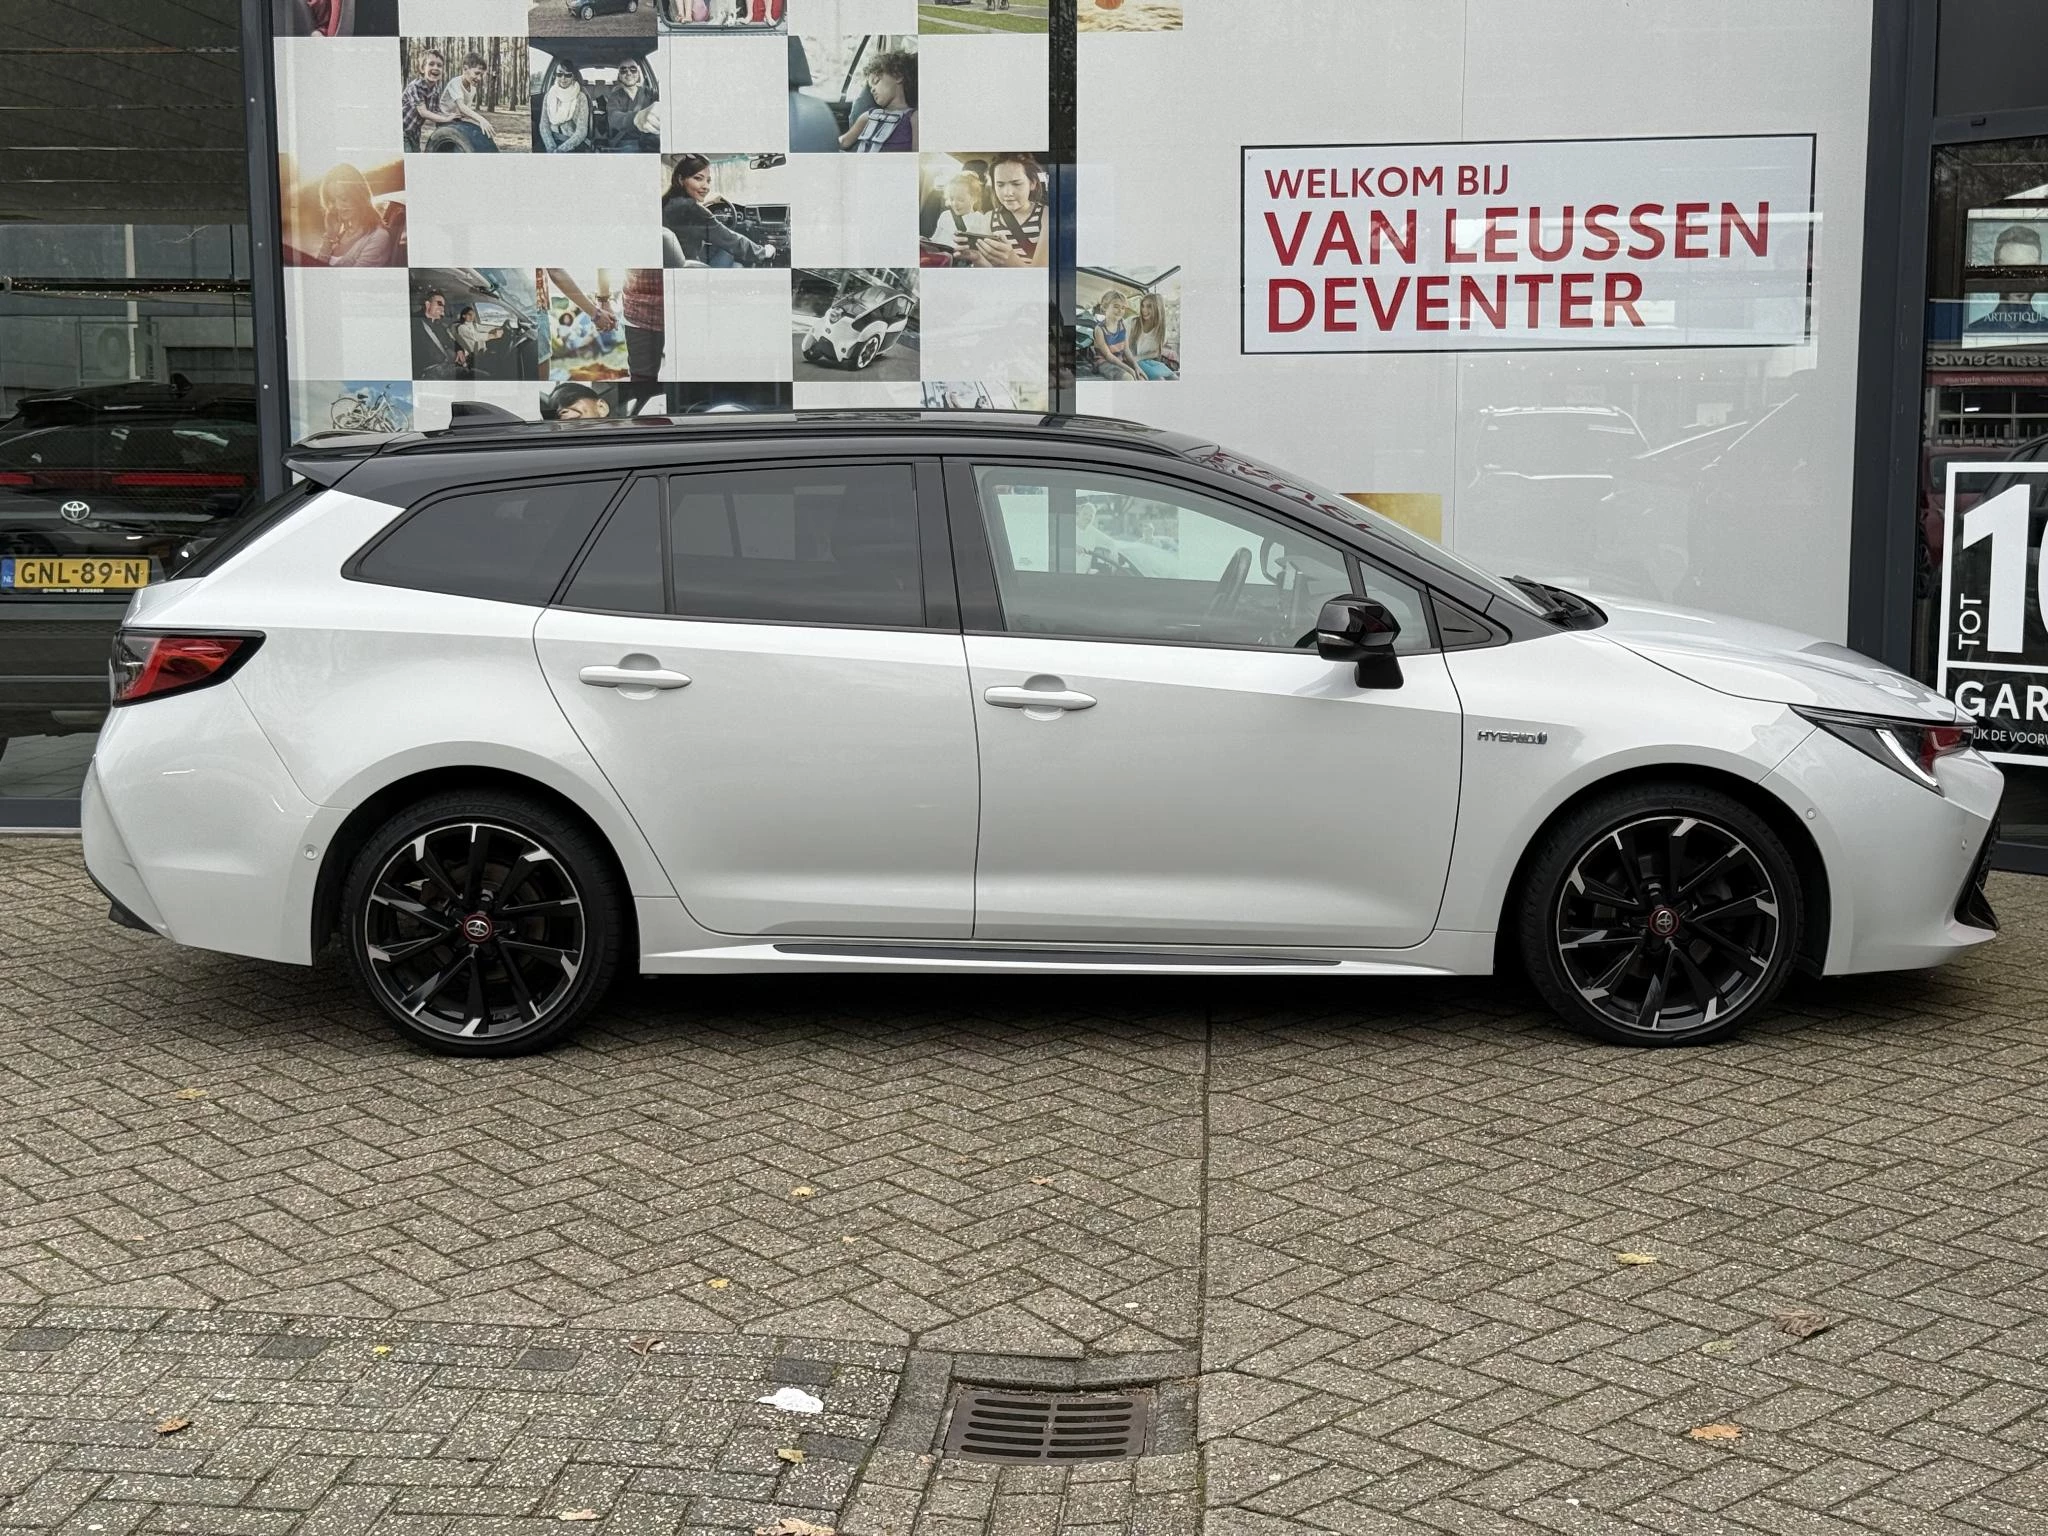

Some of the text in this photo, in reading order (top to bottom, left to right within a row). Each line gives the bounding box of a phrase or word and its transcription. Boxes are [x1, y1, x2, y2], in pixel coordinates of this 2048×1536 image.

[1265, 164, 1509, 199] WELKOM BIJ
[1264, 201, 1771, 267] VAN LEUSSEN
[1267, 271, 1646, 334] DEVENTER
[3, 575, 13, 583] NL
[21, 562, 140, 585] GNL-89-N
[1963, 483, 2048, 654] 1
[1958, 592, 1982, 651] TOT
[1477, 729, 1536, 745] HYBRID
[1973, 727, 1989, 740] IJK
[1991, 729, 2007, 742] DE
